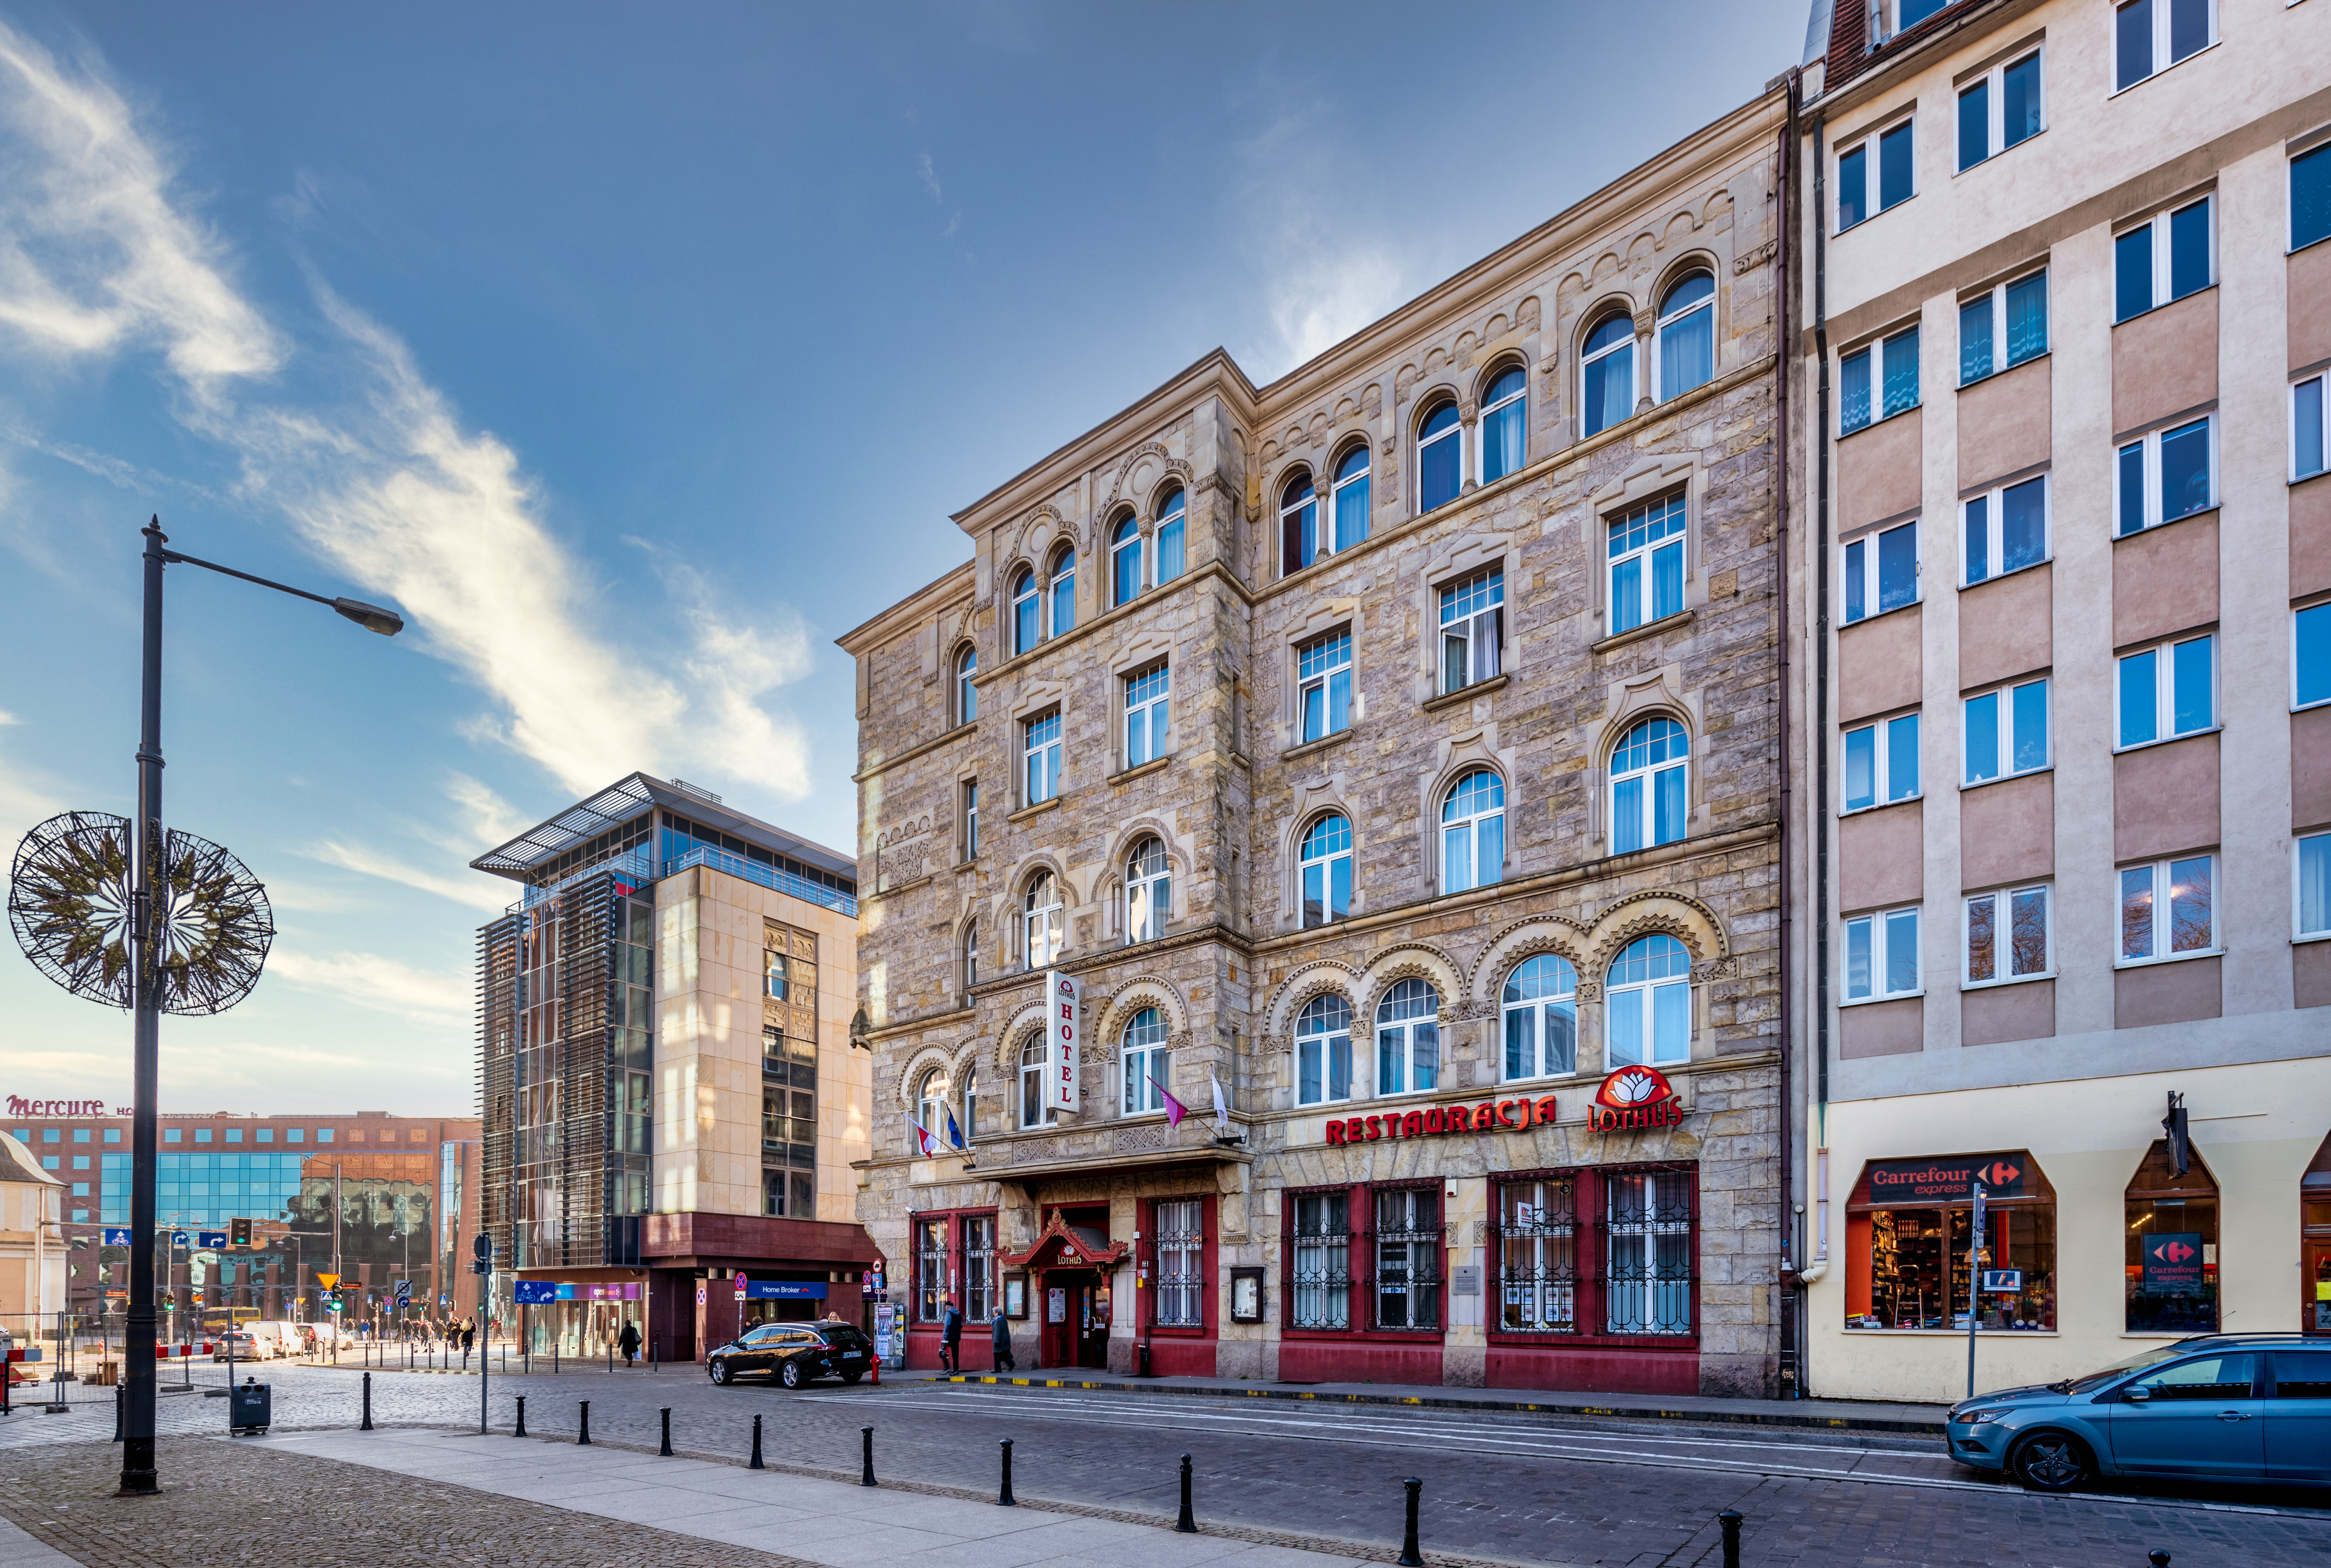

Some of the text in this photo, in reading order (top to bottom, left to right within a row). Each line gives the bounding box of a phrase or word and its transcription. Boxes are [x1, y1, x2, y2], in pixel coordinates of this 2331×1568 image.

[1058, 987, 1075, 1000] LOTHUS
[1061, 1003, 1073, 1103] HOTEL
[1326, 1095, 1556, 1145] RESTAURACJA
[1587, 1095, 1683, 1132] LOTHUS
[1873, 1167, 1970, 1185] Carrefour
[1914, 1184, 1967, 1196] express
[1057, 1254, 1082, 1265] LOTHUS
[593, 1289, 604, 1298] open
